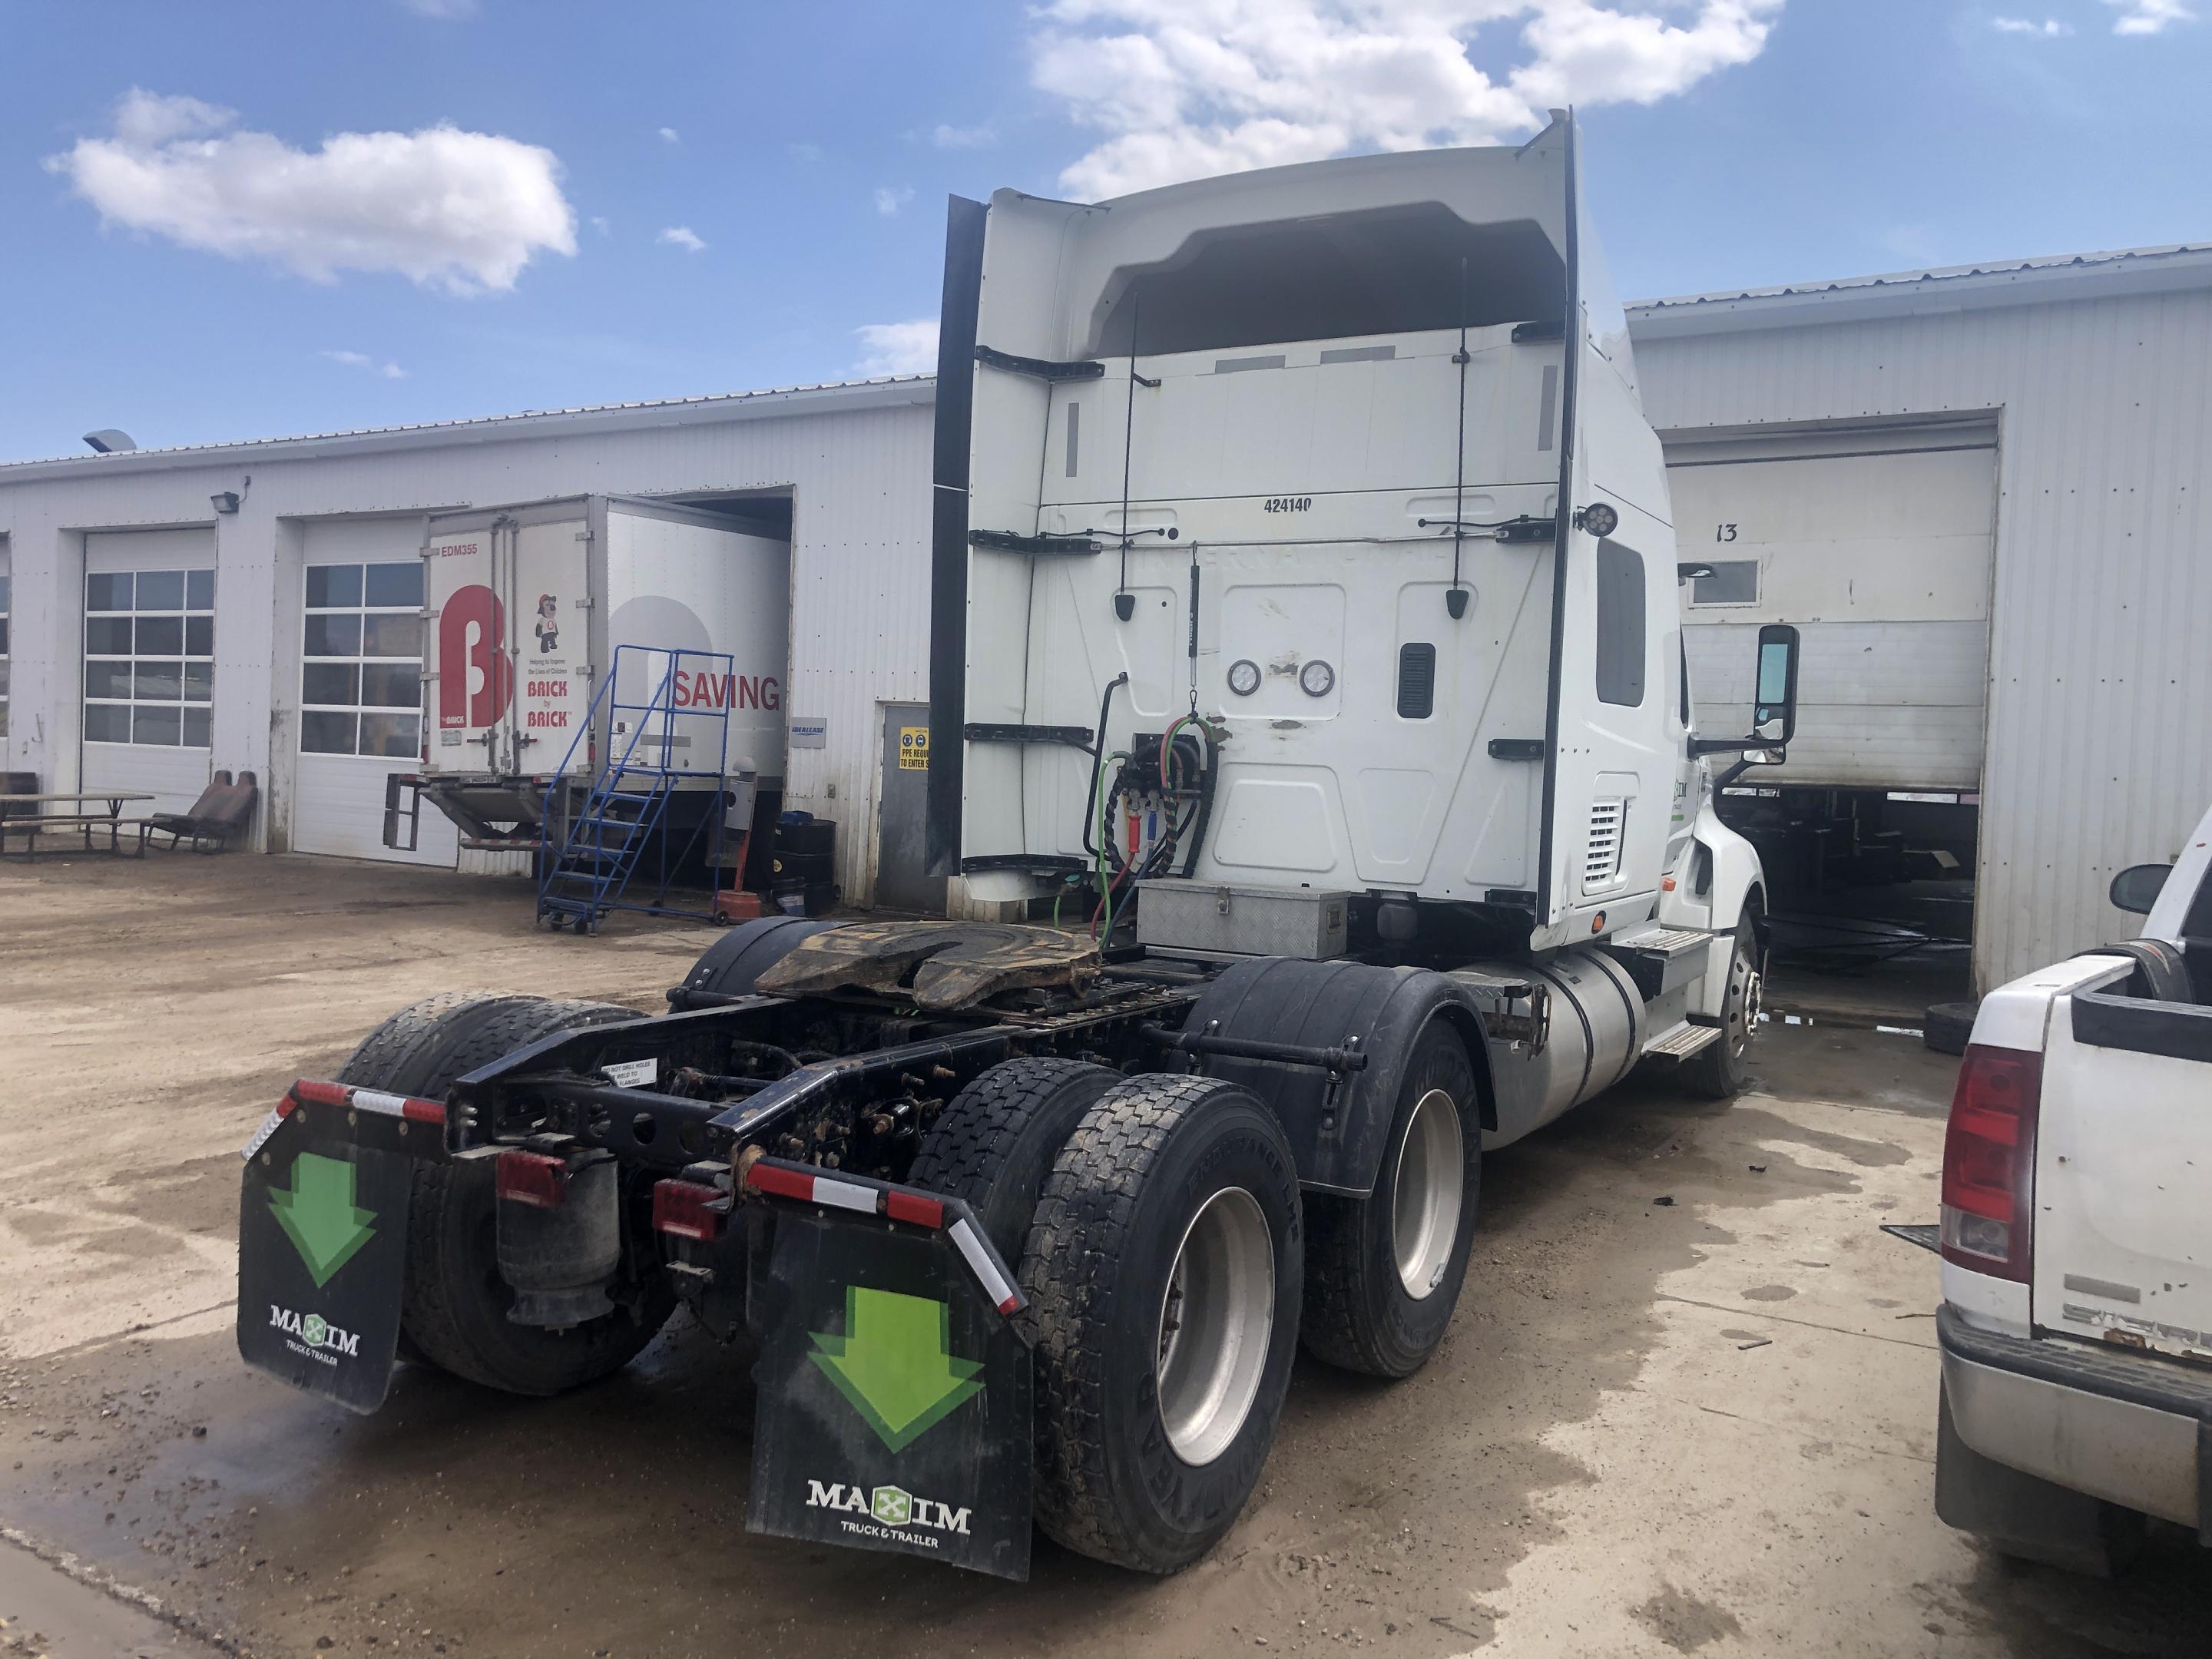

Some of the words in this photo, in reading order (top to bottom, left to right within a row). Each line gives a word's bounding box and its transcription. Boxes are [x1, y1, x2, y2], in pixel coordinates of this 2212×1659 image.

[1717, 524, 1737, 542] 13
[442, 544, 478, 557] EDM355
[528, 680, 568, 697] BRICK
[672, 671, 780, 710] SAVING
[544, 700, 551, 709] by
[902, 749, 912, 757] PPE
[900, 759, 907, 767] TO
[909, 759, 925, 768] ENTER
[270, 1304, 360, 1356] MAXIM
[2062, 1302, 2212, 1349] SIER
[806, 1479, 972, 1535] MAXIM
[841, 1521, 879, 1536] TRUCK
[890, 1530, 939, 1548] TRAILER
